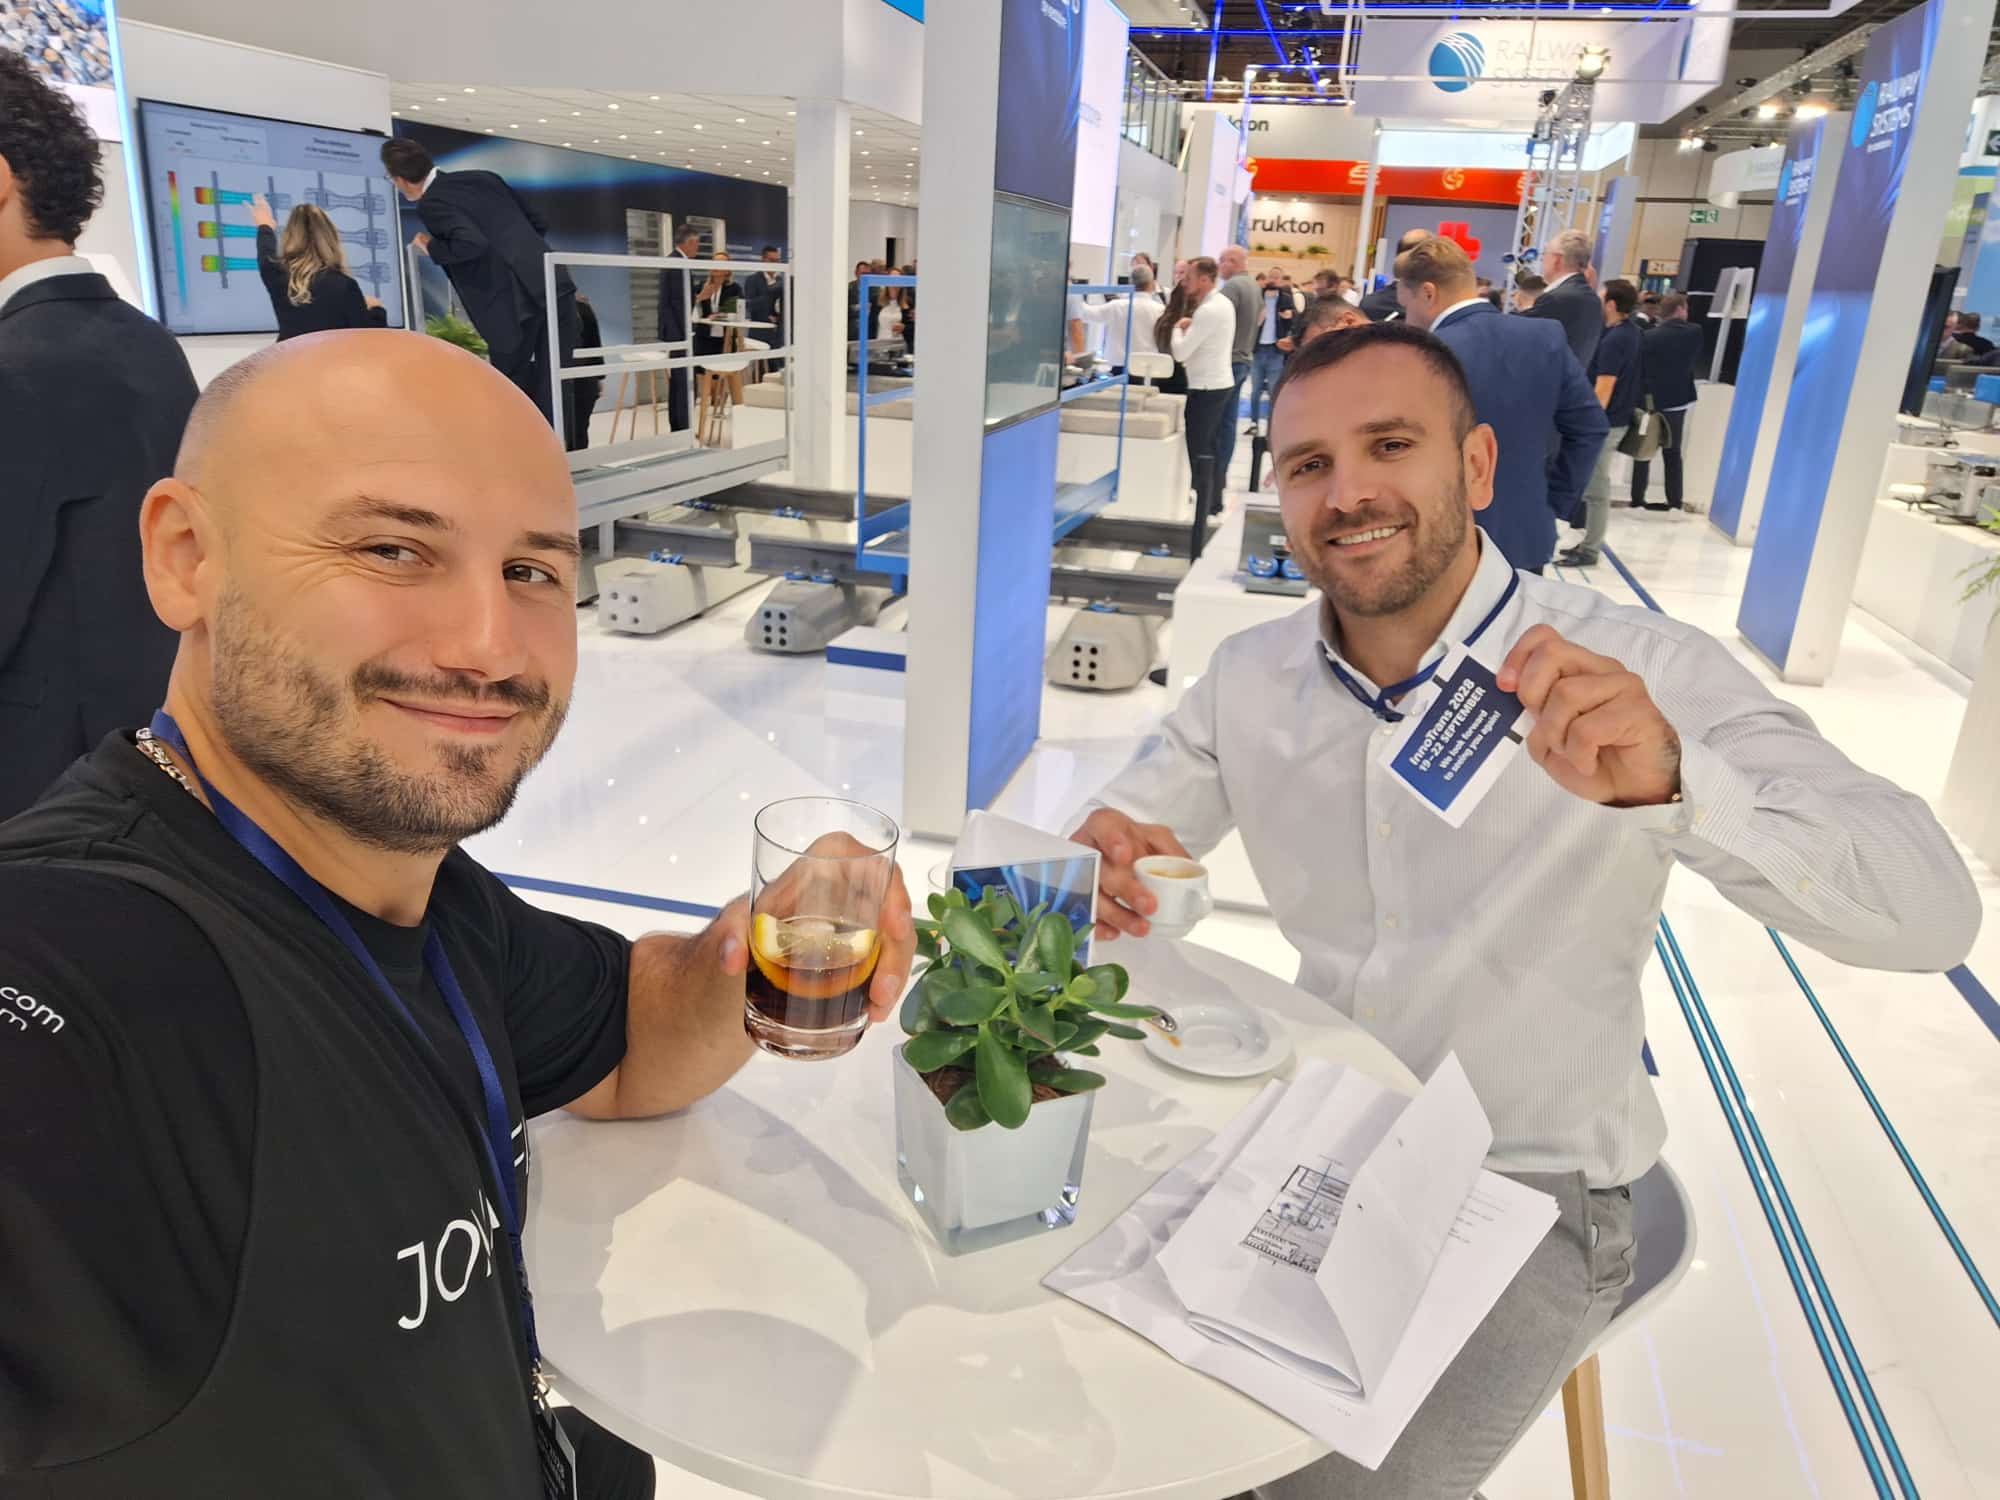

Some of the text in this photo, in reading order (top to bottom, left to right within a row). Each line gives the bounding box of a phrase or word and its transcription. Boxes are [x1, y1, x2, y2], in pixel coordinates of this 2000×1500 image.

[1409, 678, 1475, 765] InnoTrans 2028
[1440, 687, 1486, 743] SEPTEMBER
[1450, 739, 1465, 756] look
[1461, 710, 1487, 740] forward
[1443, 772, 1454, 781] to
[1451, 748, 1473, 771] seeing
[1470, 734, 1483, 750] you
